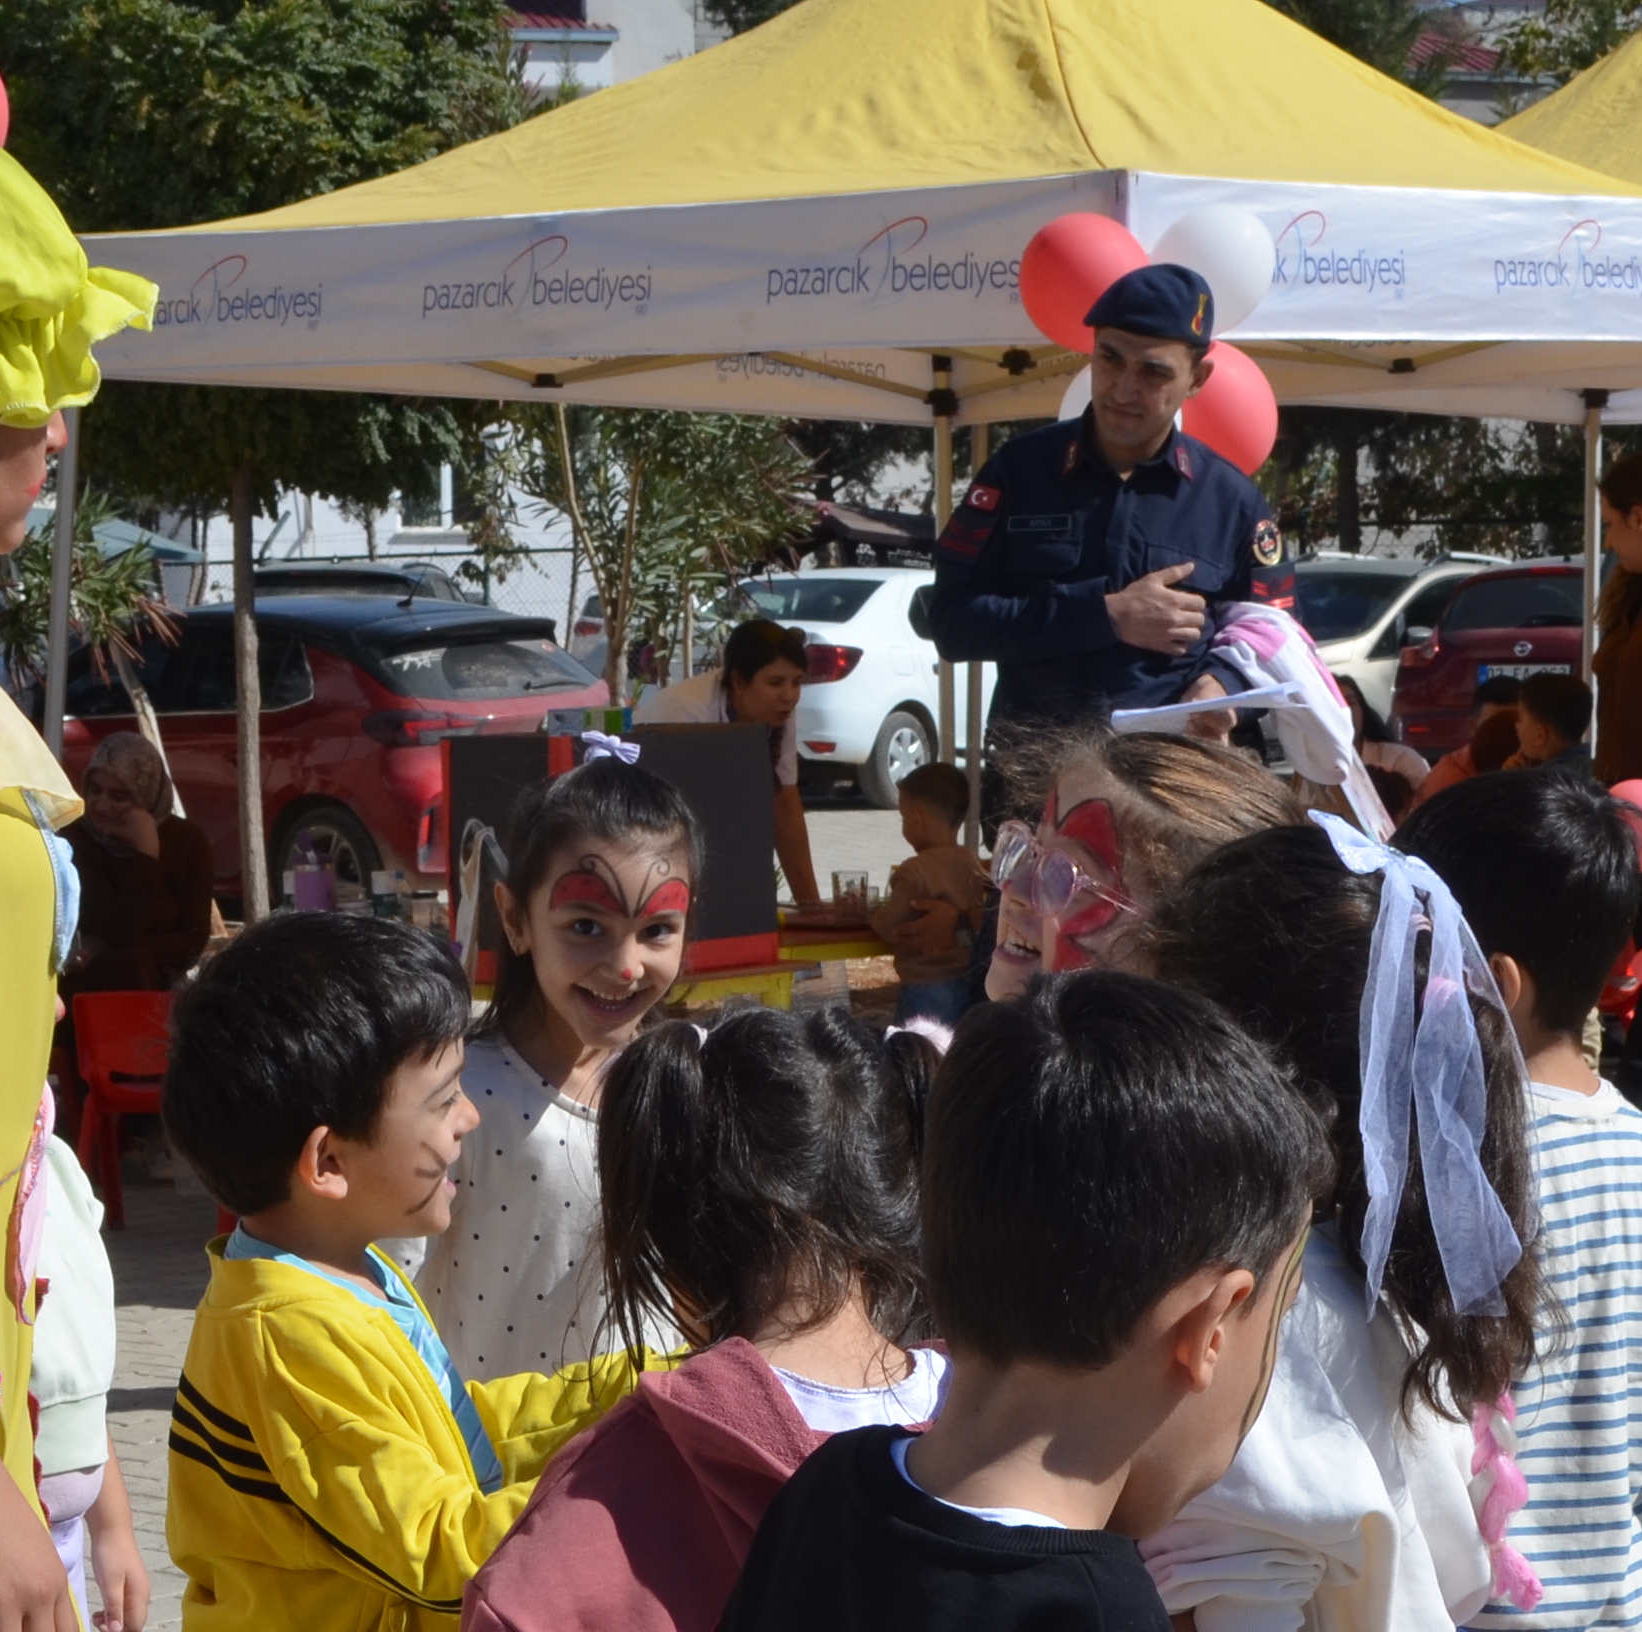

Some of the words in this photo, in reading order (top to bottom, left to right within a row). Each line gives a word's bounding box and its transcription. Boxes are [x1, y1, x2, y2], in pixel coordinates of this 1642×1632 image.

[422, 273, 515, 319] pazarcık
[531, 264, 652, 312] belediyesi
[766, 256, 870, 305] pazarcık
[891, 252, 1021, 299] belediyes
[1303, 248, 1406, 293] belediyesi
[1494, 252, 1571, 294] pazarcık
[216, 283, 323, 327] belediyesi
